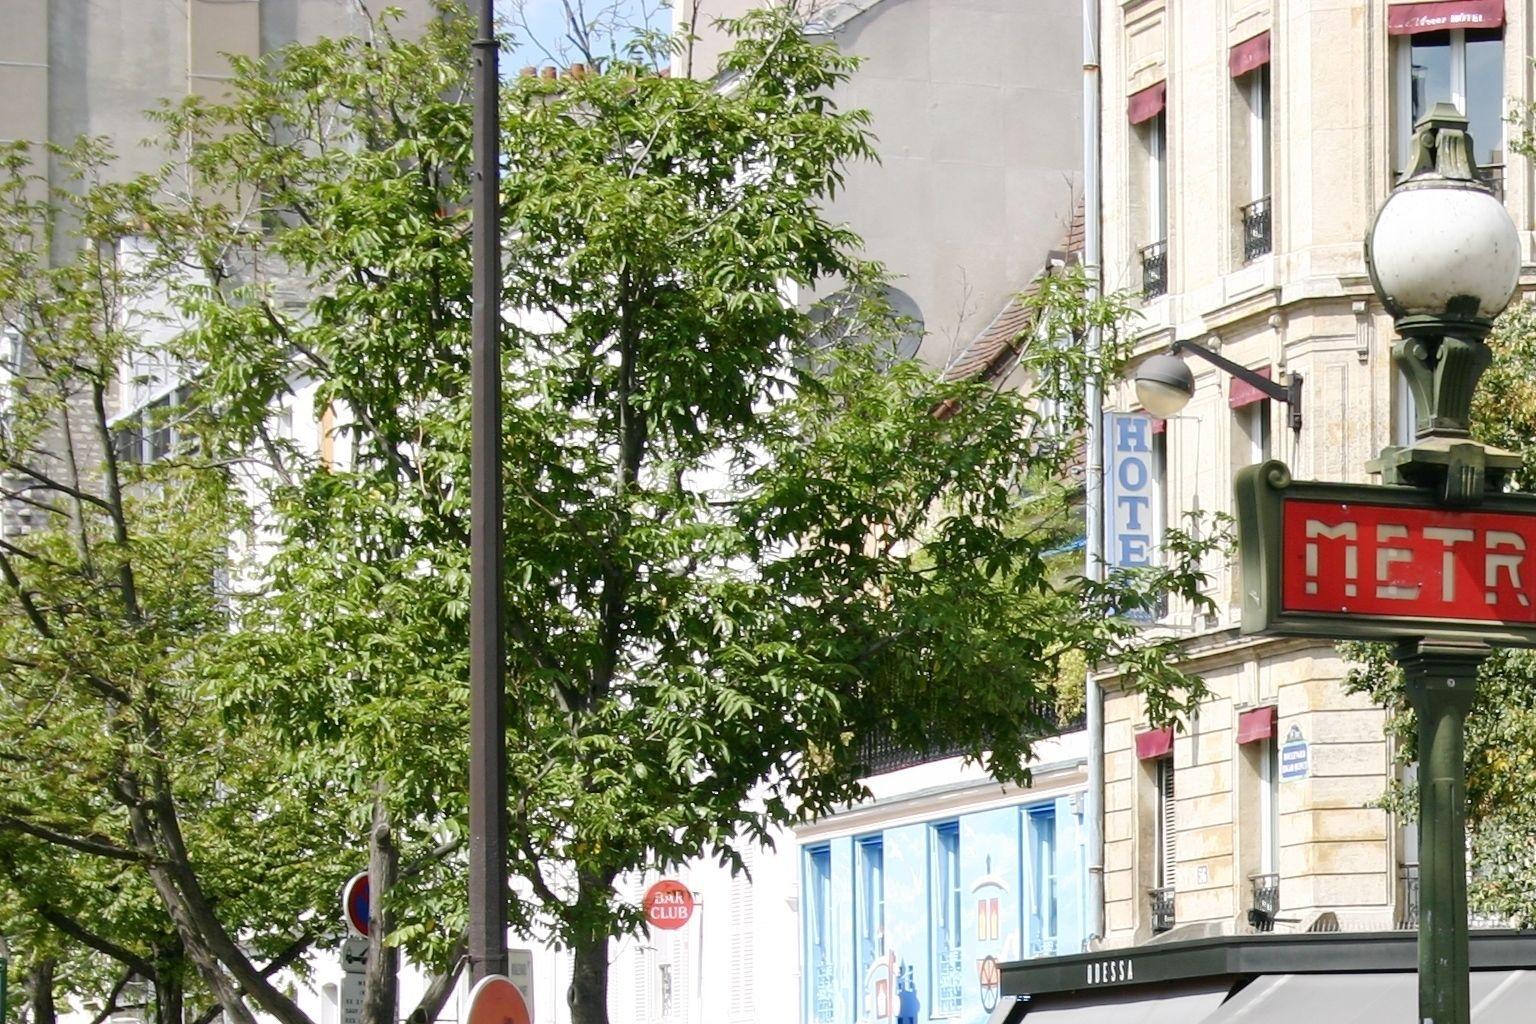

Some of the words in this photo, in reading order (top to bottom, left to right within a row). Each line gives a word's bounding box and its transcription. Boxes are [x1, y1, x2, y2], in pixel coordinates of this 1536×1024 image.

[1117, 418, 1150, 580] HOTE
[654, 891, 684, 904] BAR
[651, 906, 688, 919] CLUB
[1087, 960, 1133, 984] ODESSA
